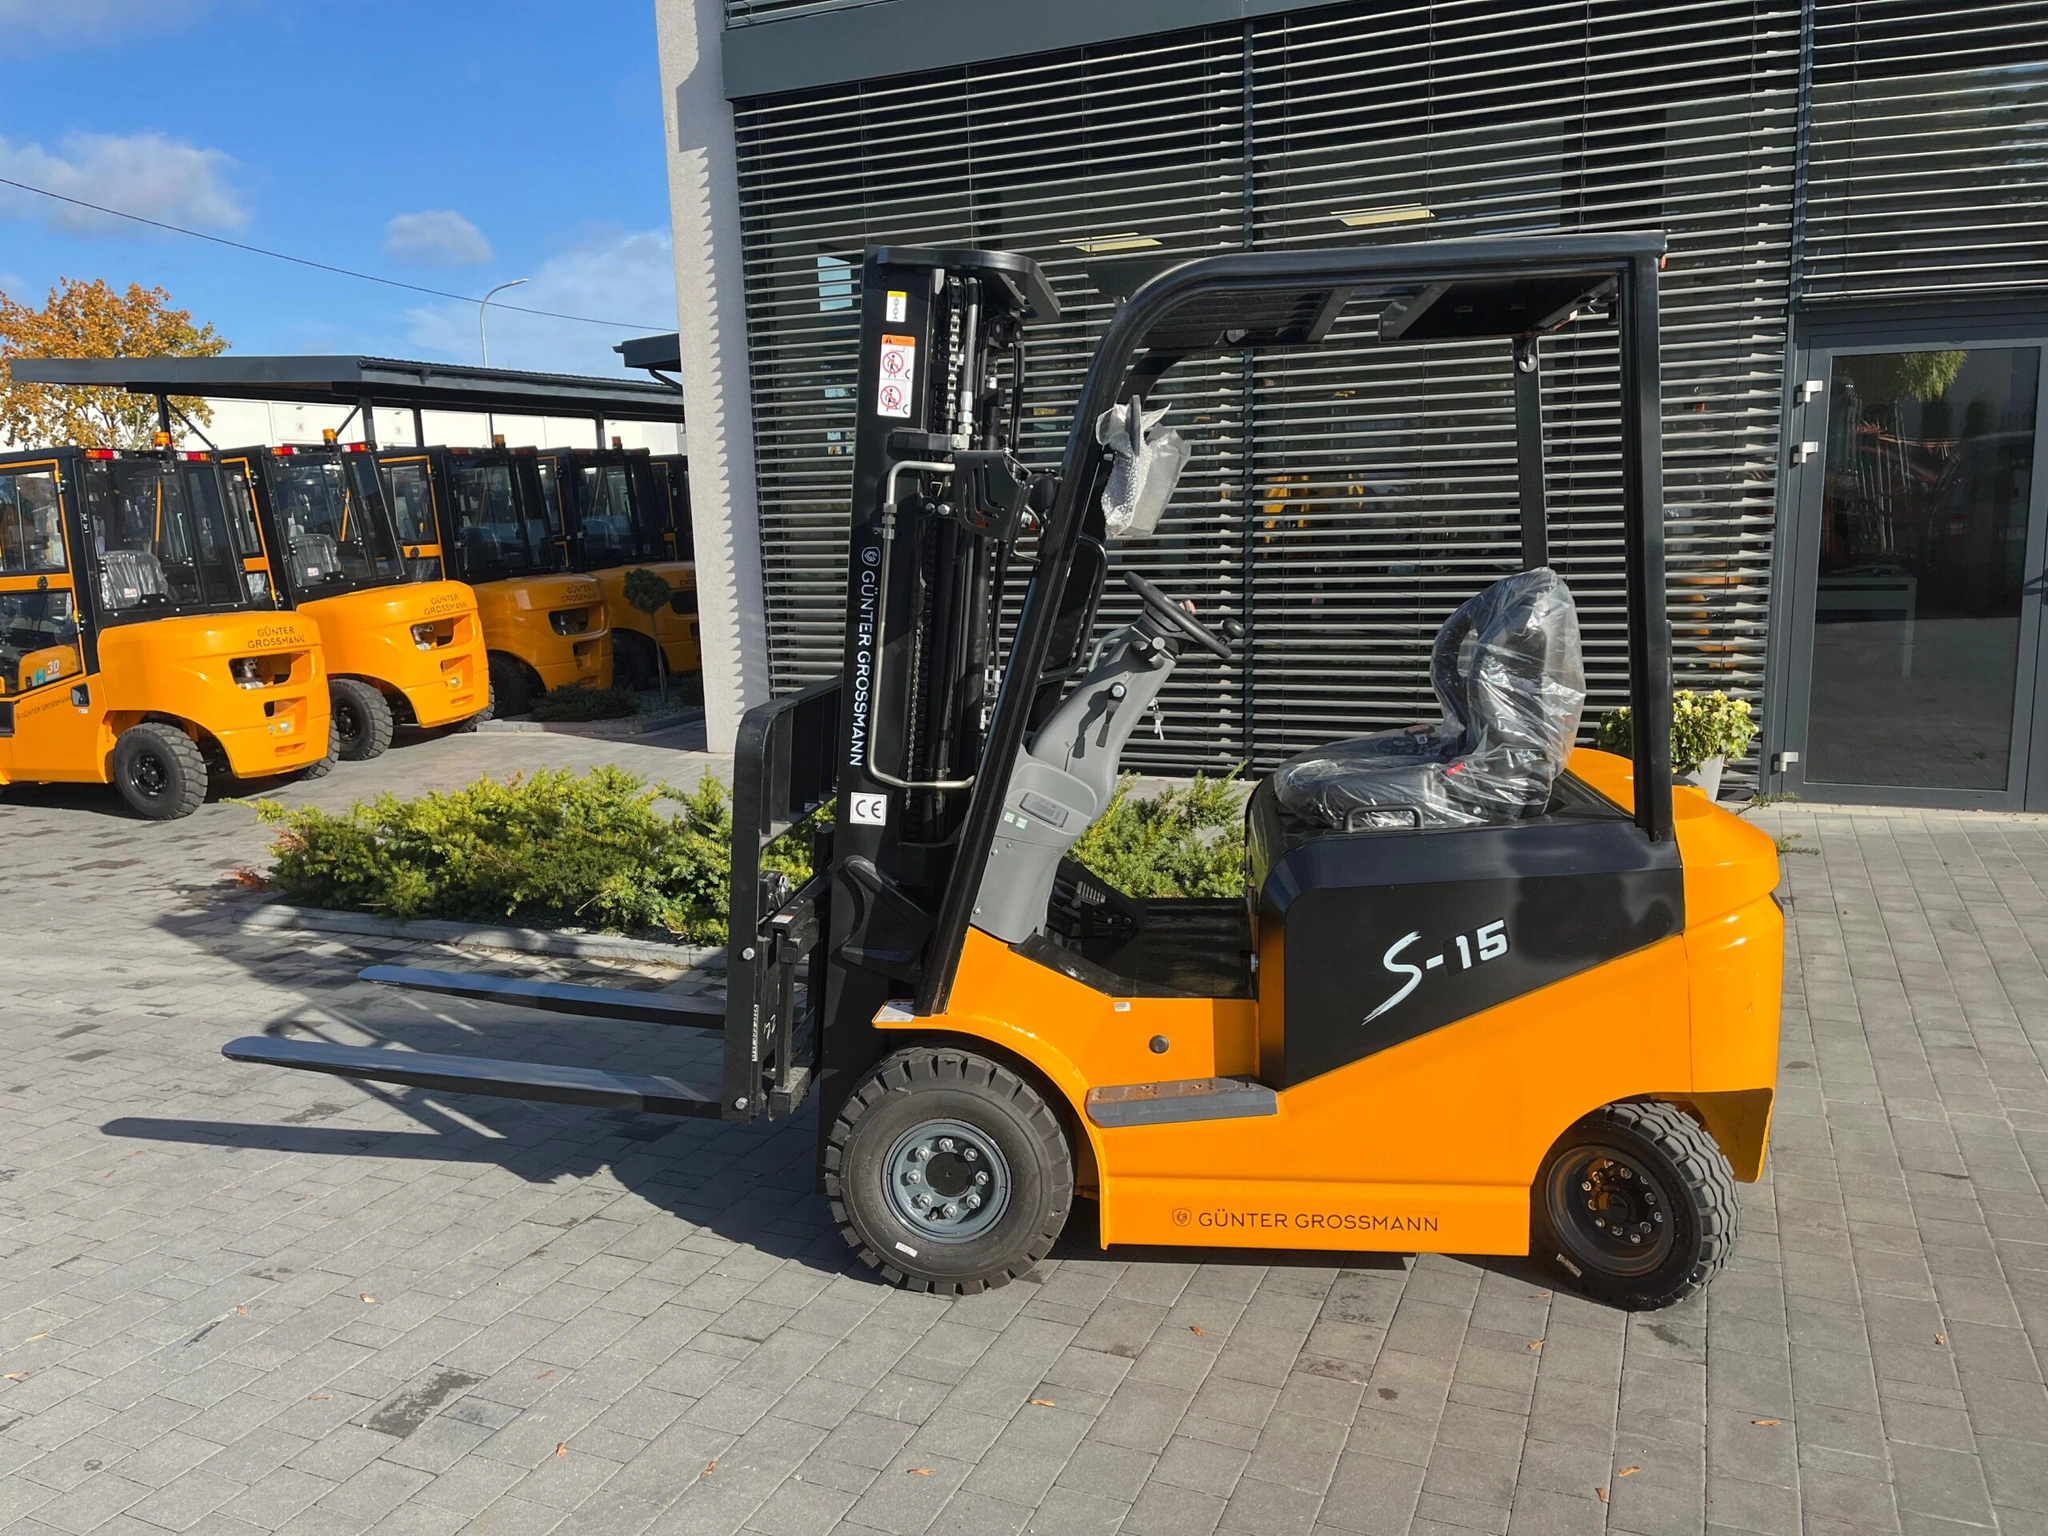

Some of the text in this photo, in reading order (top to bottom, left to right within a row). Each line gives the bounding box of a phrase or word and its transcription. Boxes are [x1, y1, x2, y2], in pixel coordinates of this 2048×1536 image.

[430, 593, 459, 604] GÜNTER
[424, 602, 468, 615] GROSSMANN
[257, 626, 295, 637] GÜNTER
[247, 635, 305, 649] GROSSMANN
[47, 659, 60, 674] 30
[850, 570, 879, 766] GÜNTER GROSSMANN
[34, 667, 46, 686] H
[856, 799, 882, 819] CE
[1198, 1208, 1438, 1231] GÜNTER GROSSMANN
